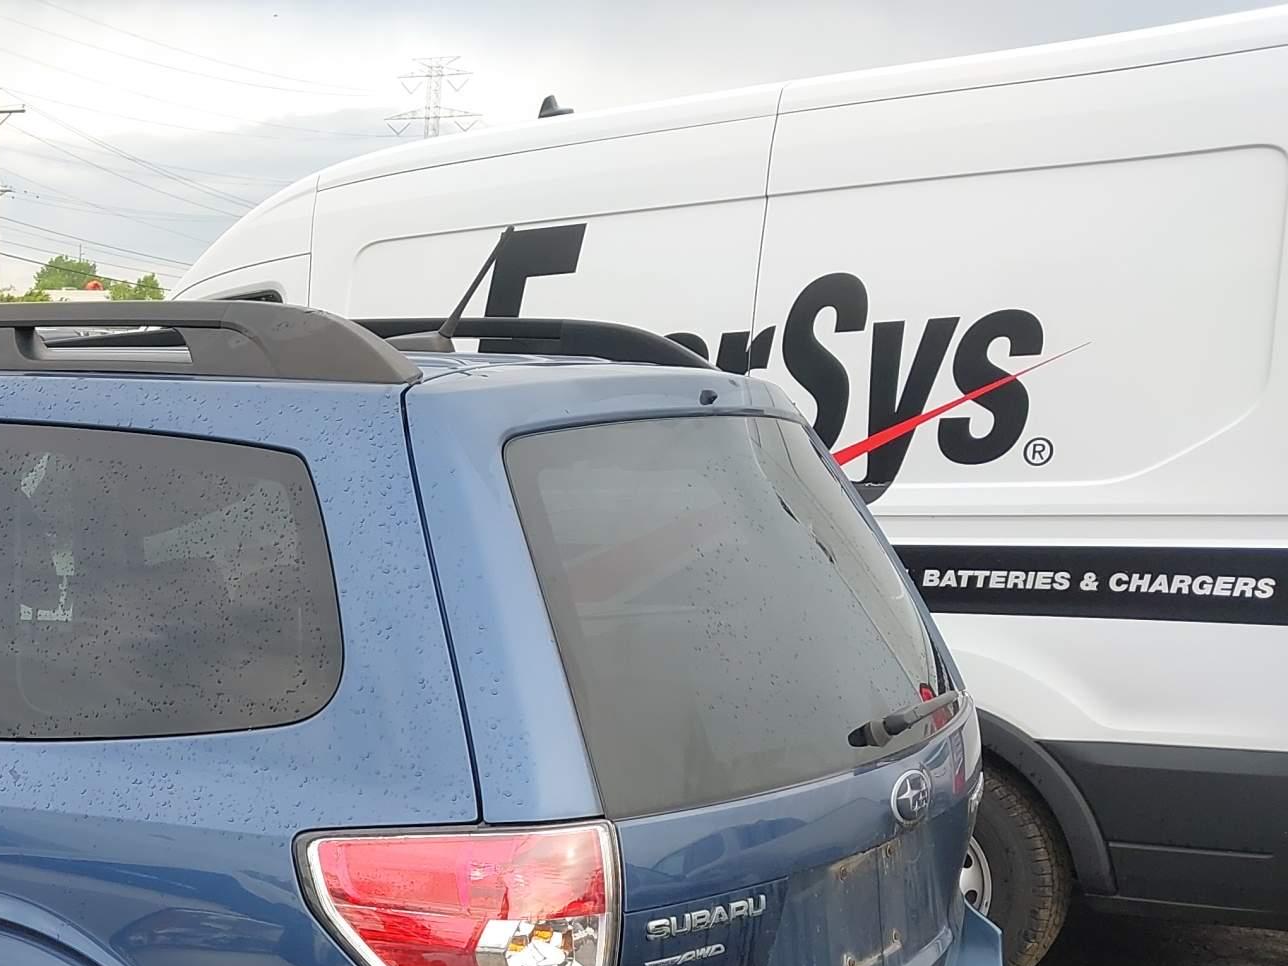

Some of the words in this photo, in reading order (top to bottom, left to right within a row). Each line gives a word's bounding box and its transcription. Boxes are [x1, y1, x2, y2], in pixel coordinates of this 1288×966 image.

[922, 569, 1071, 591] BATTERIES
[1079, 572, 1099, 592] &
[1109, 572, 1277, 599] CHARGERS
[646, 894, 767, 941] SUBARU
